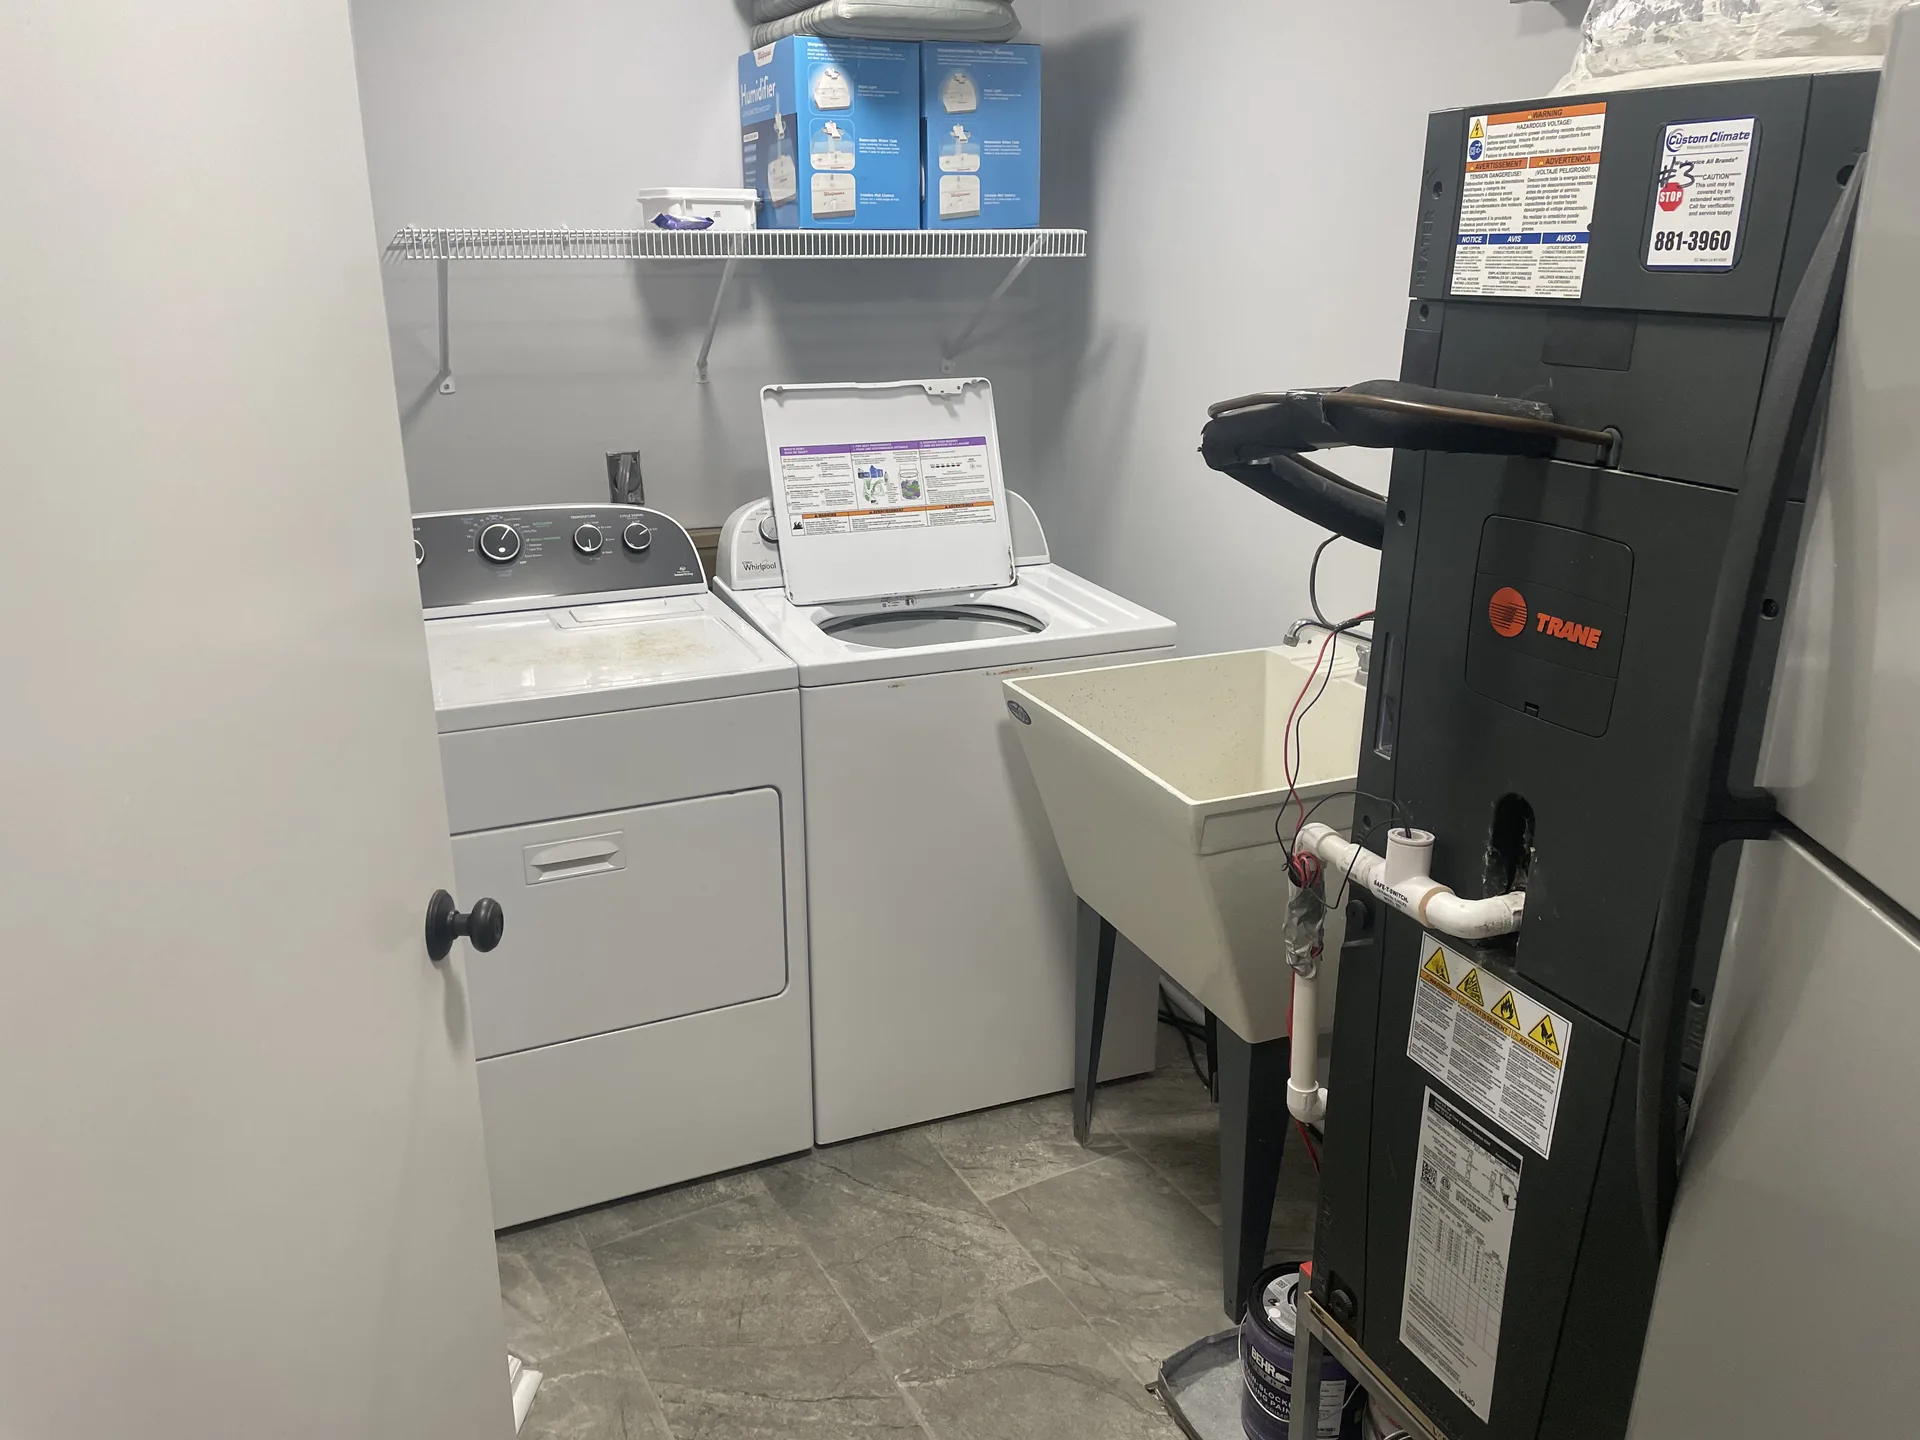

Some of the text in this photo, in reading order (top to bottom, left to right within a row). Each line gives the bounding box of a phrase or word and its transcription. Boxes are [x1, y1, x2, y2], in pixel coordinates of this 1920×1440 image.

[740, 75, 776, 106] Humidifier
[1532, 109, 1562, 118] WARNING
[1669, 131, 1750, 145] Custom Climate
[1476, 161, 1522, 169] AVERTISSEMENT
[1545, 155, 1591, 164] ADVERTENCIA
[1660, 191, 1682, 202] STOP
[1654, 230, 1732, 251] 881-3960
[743, 562, 776, 571] Whirlpool
[1537, 612, 1602, 649] TRANE
[1520, 1038, 1559, 1066] ADVERTENCIA
[1251, 1346, 1276, 1377] BEHR
